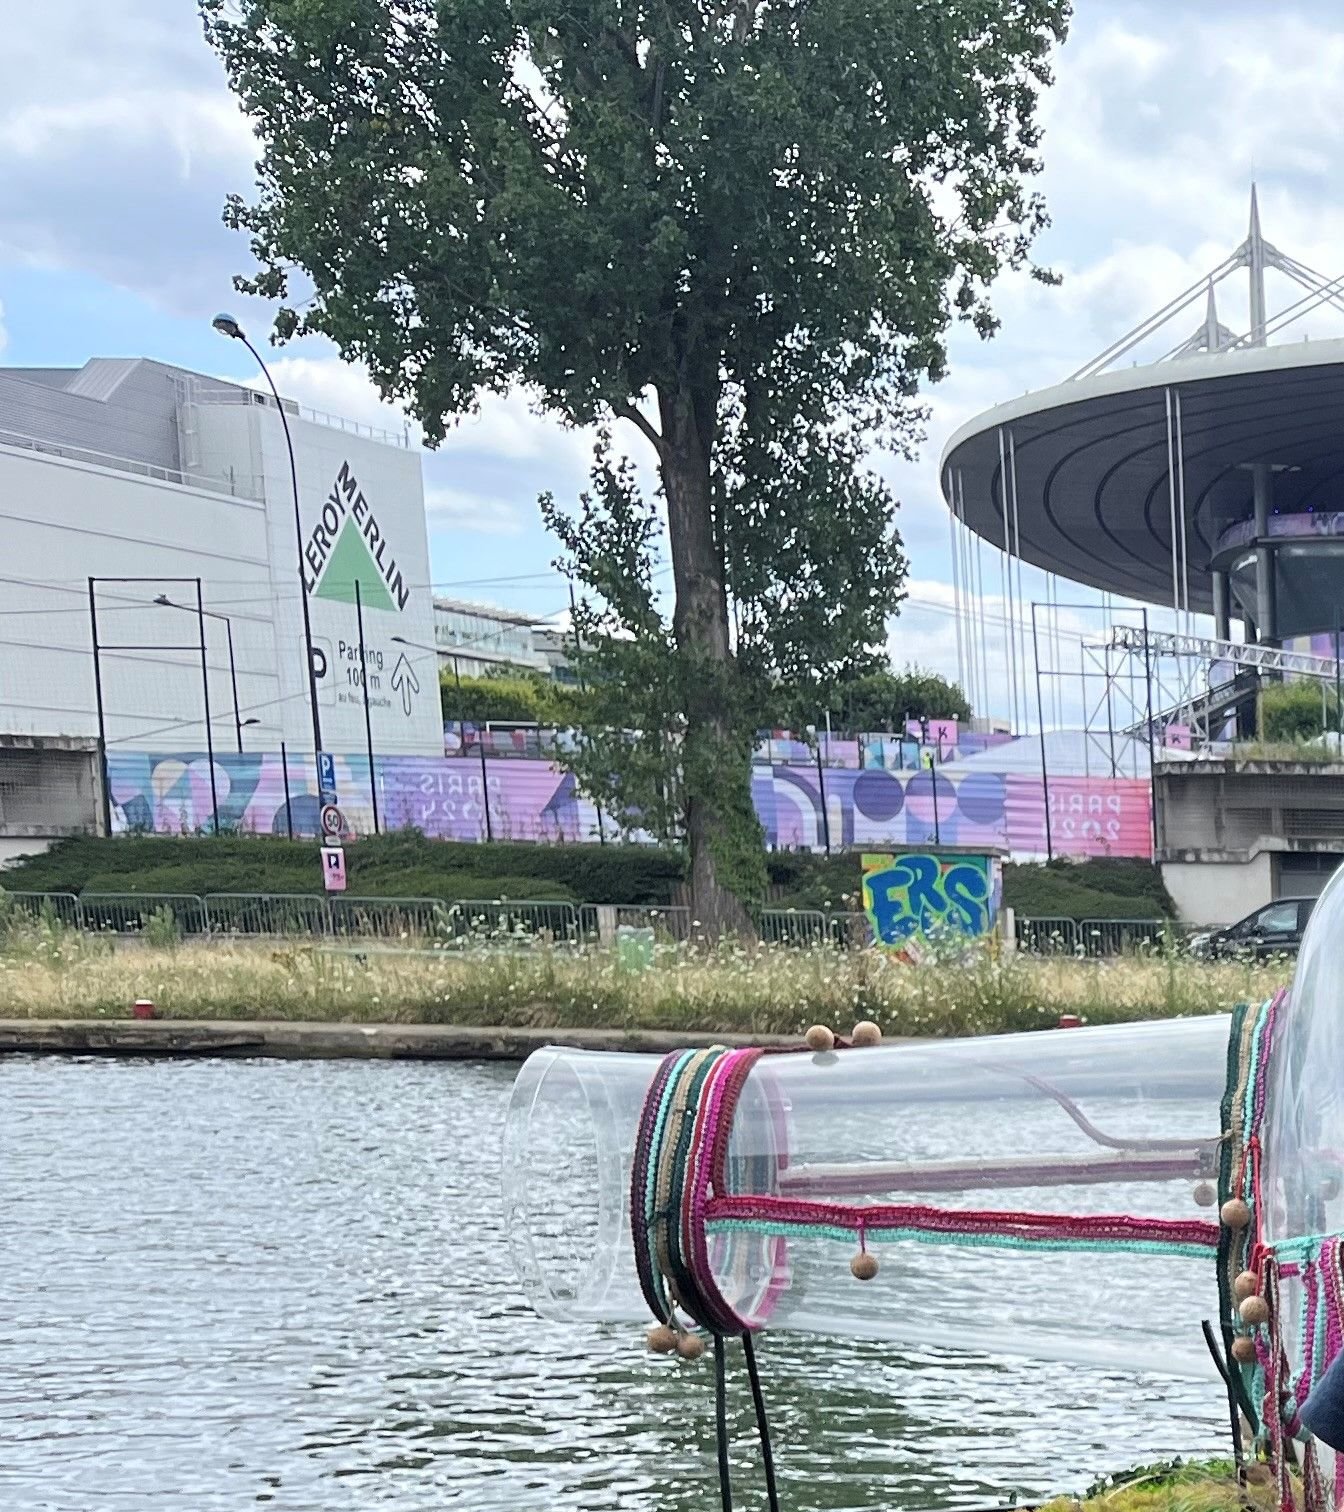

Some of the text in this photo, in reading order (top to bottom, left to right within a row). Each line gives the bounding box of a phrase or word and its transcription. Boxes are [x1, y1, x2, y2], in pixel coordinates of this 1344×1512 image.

[299, 459, 410, 612] LEROY MERLIN
[327, 814, 339, 828] 50
